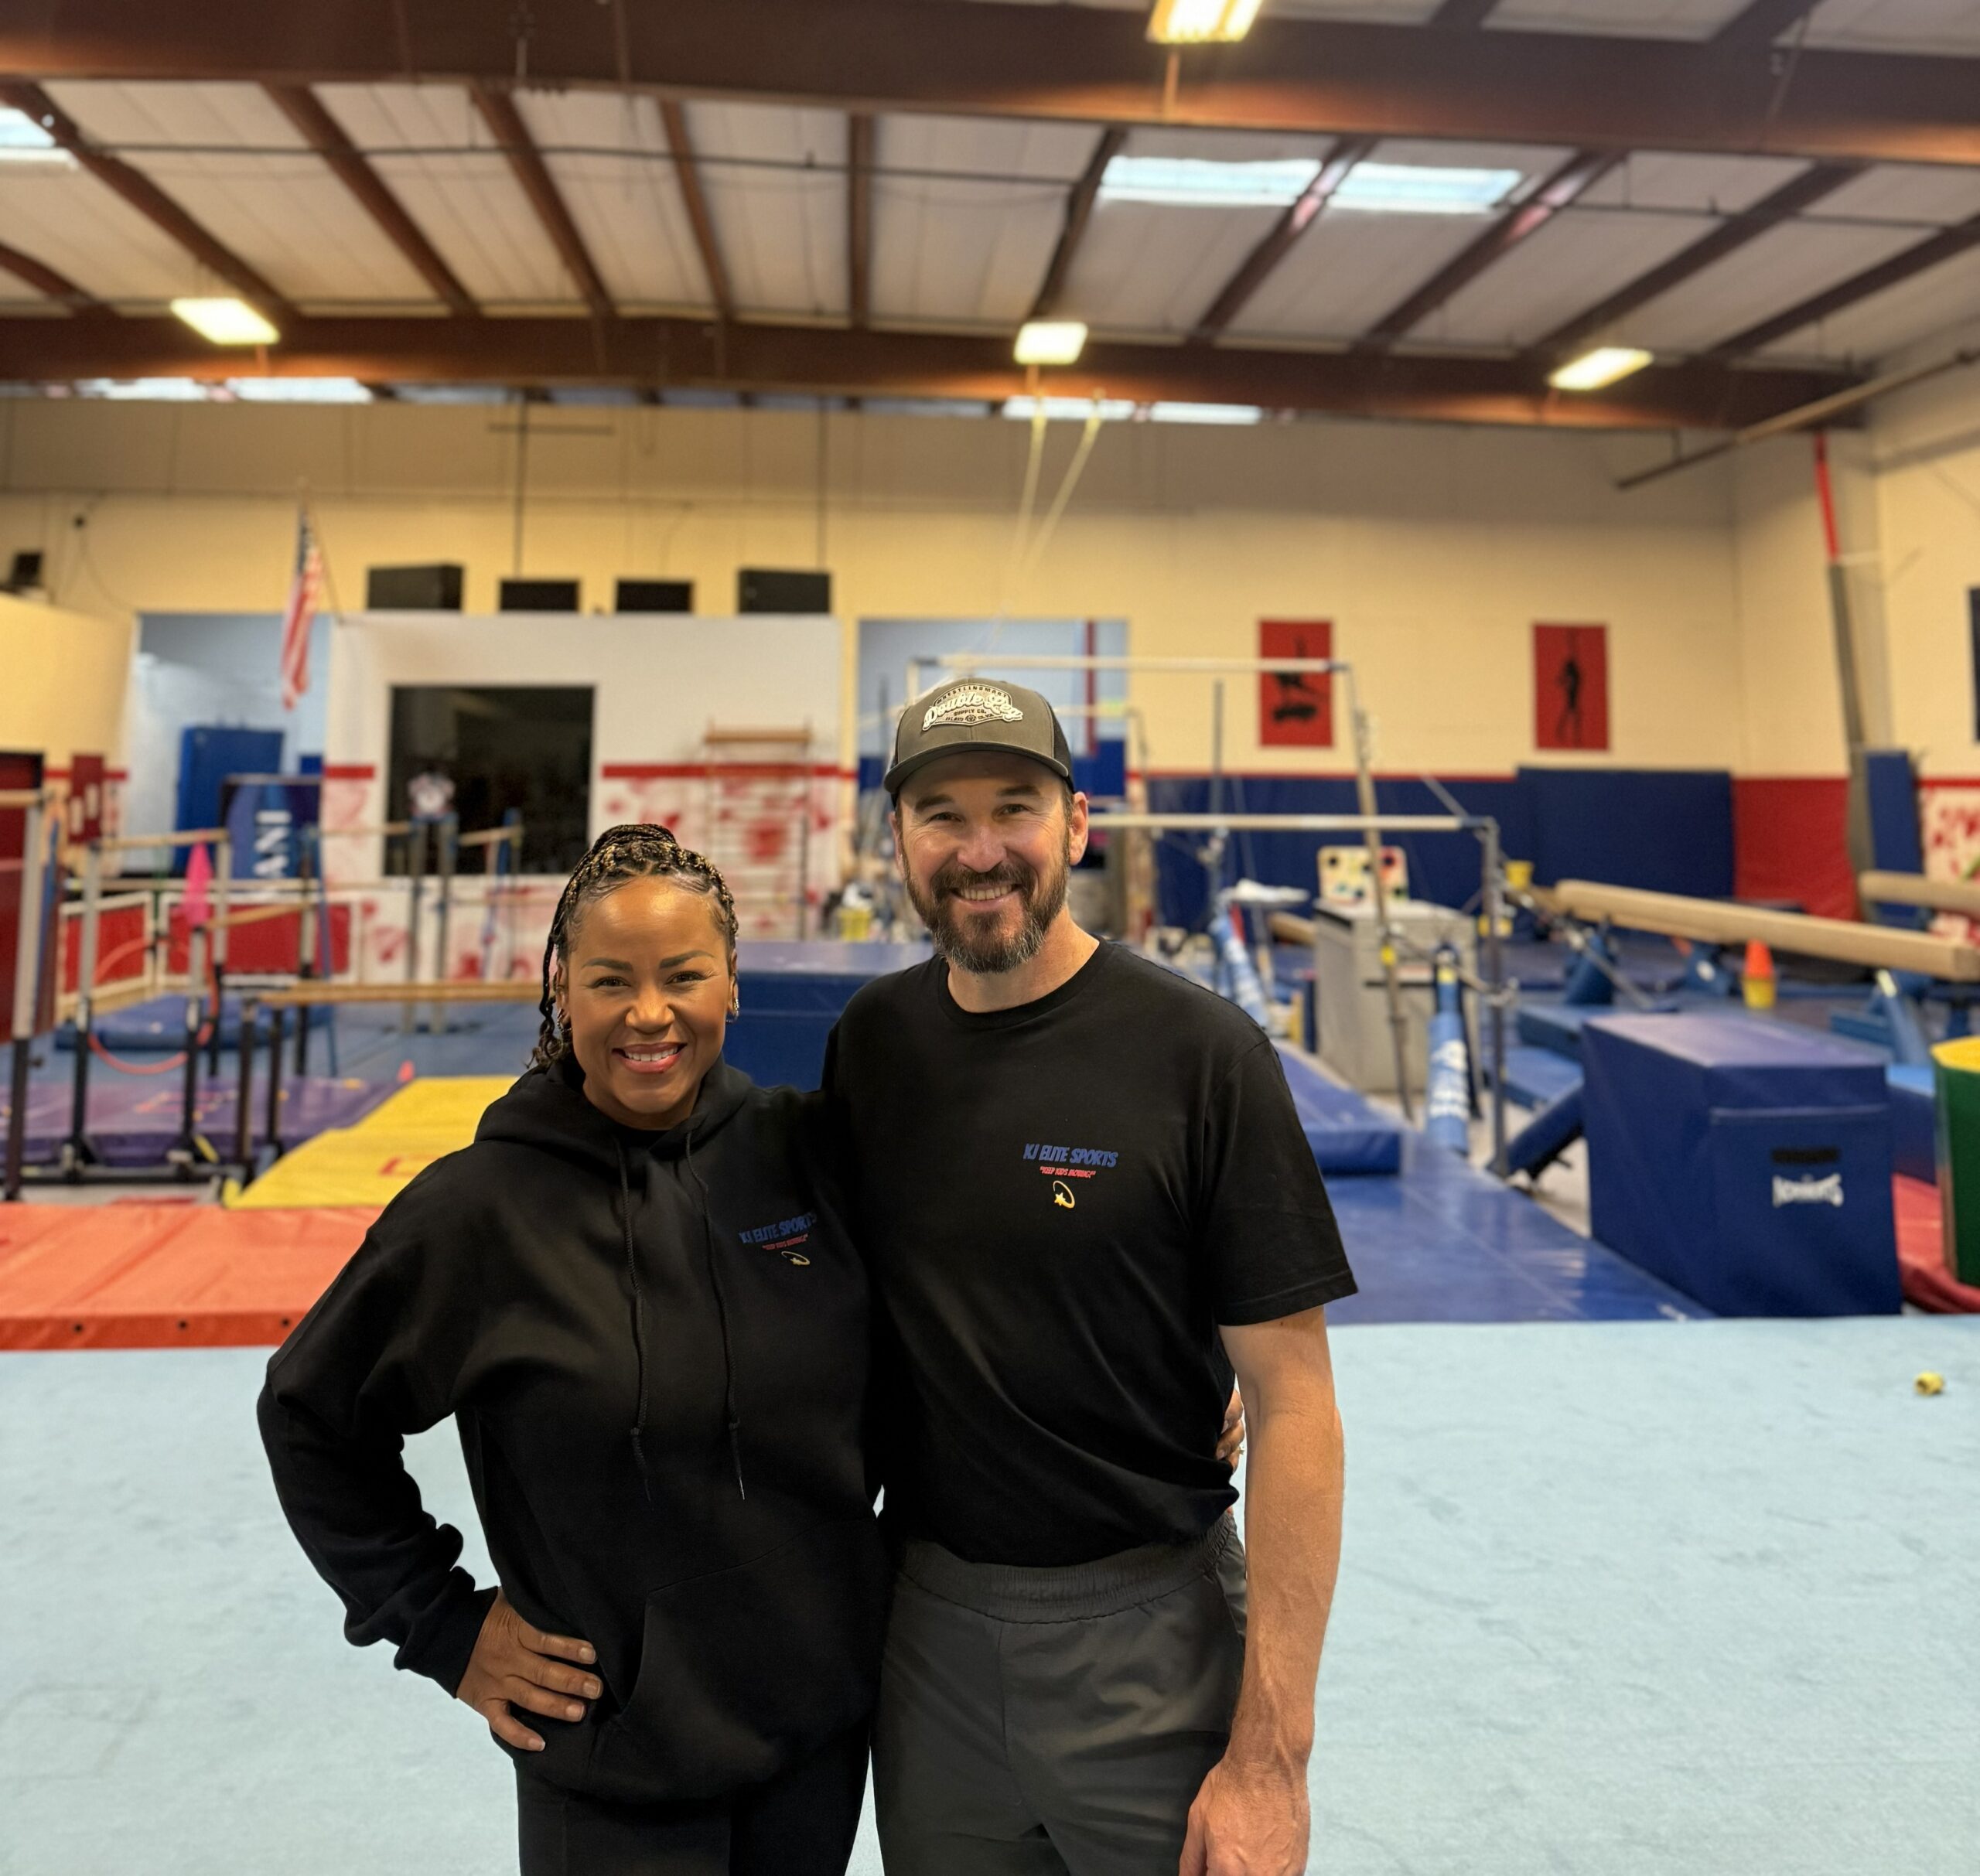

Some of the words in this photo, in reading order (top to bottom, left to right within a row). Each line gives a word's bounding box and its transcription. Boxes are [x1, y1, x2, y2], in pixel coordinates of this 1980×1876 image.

[923, 692, 984, 731] Double
[1022, 1143, 1040, 1160] KJ
[1039, 1144, 1070, 1162] ELITE
[1070, 1148, 1119, 1168] SPORTS
